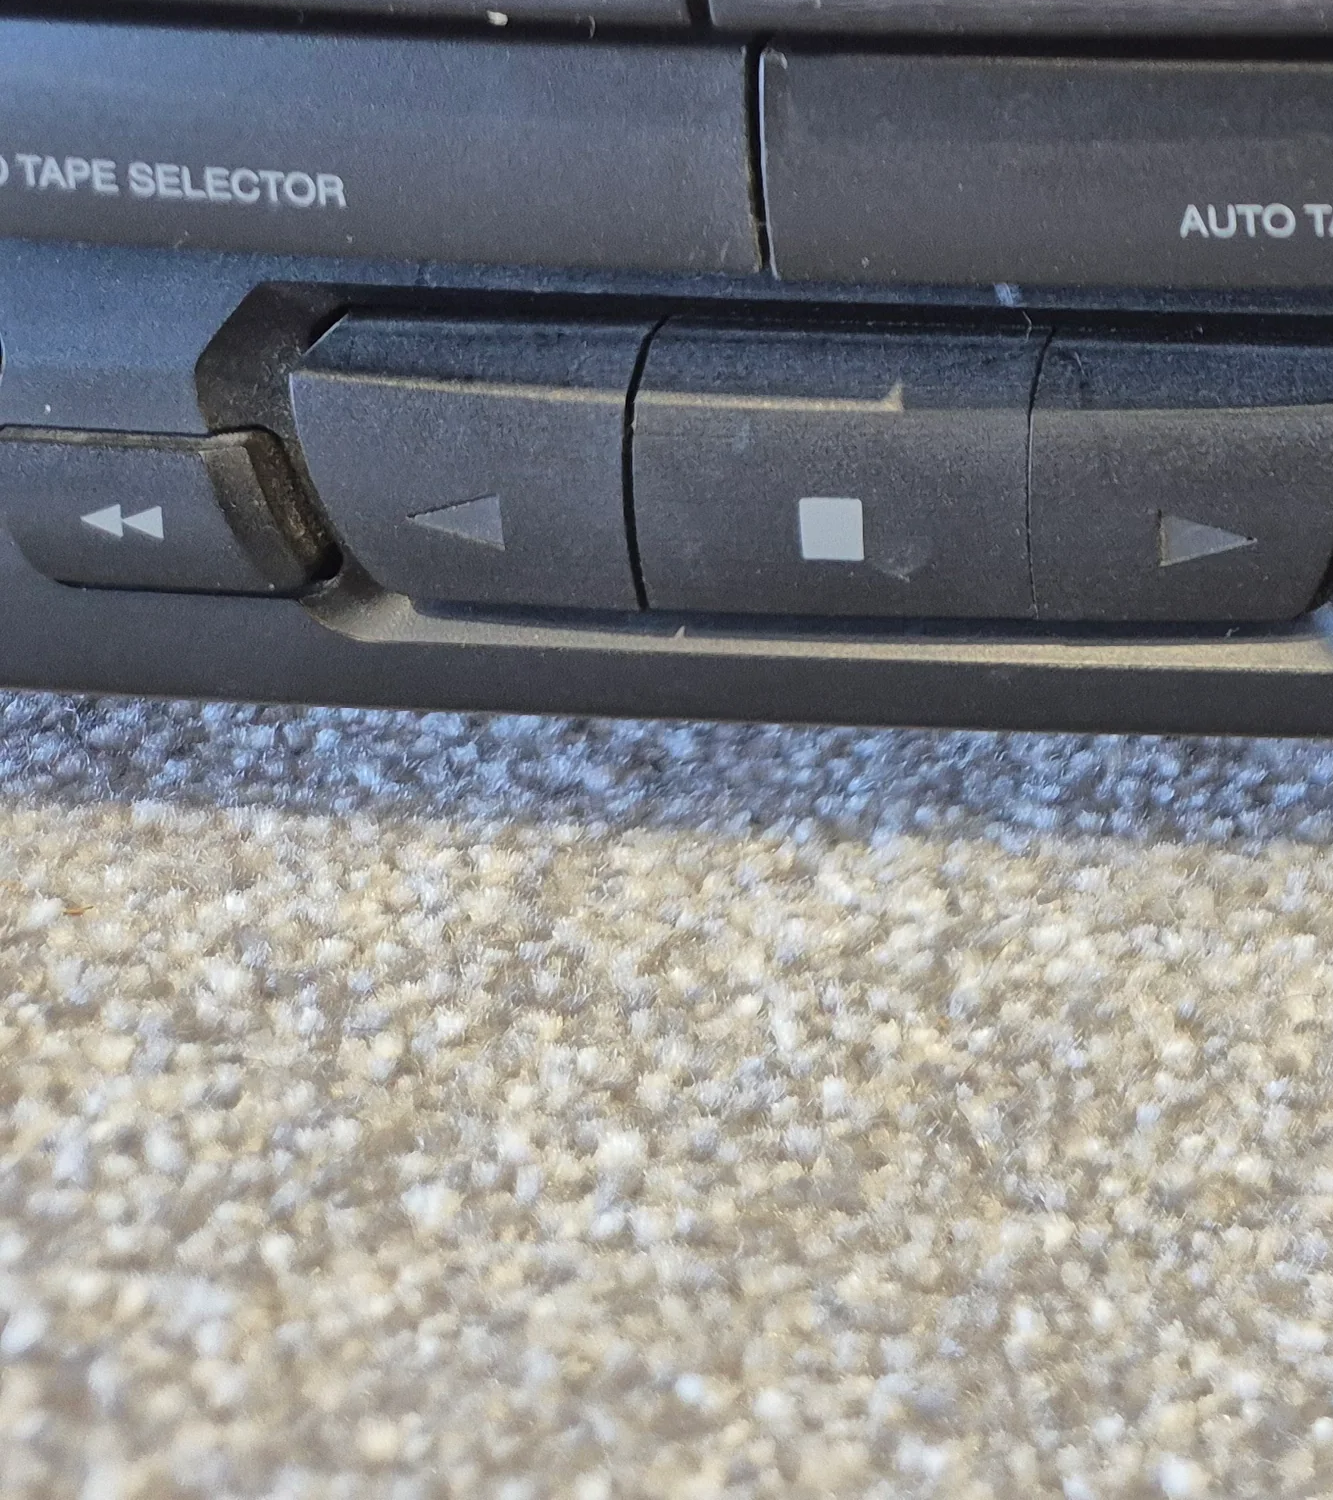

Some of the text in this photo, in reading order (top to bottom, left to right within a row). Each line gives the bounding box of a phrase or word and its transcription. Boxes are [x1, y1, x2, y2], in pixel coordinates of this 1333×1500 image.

[15, 153, 119, 194] TAPE
[127, 161, 347, 208] SELECTOR
[1179, 203, 1297, 239] AUTO
